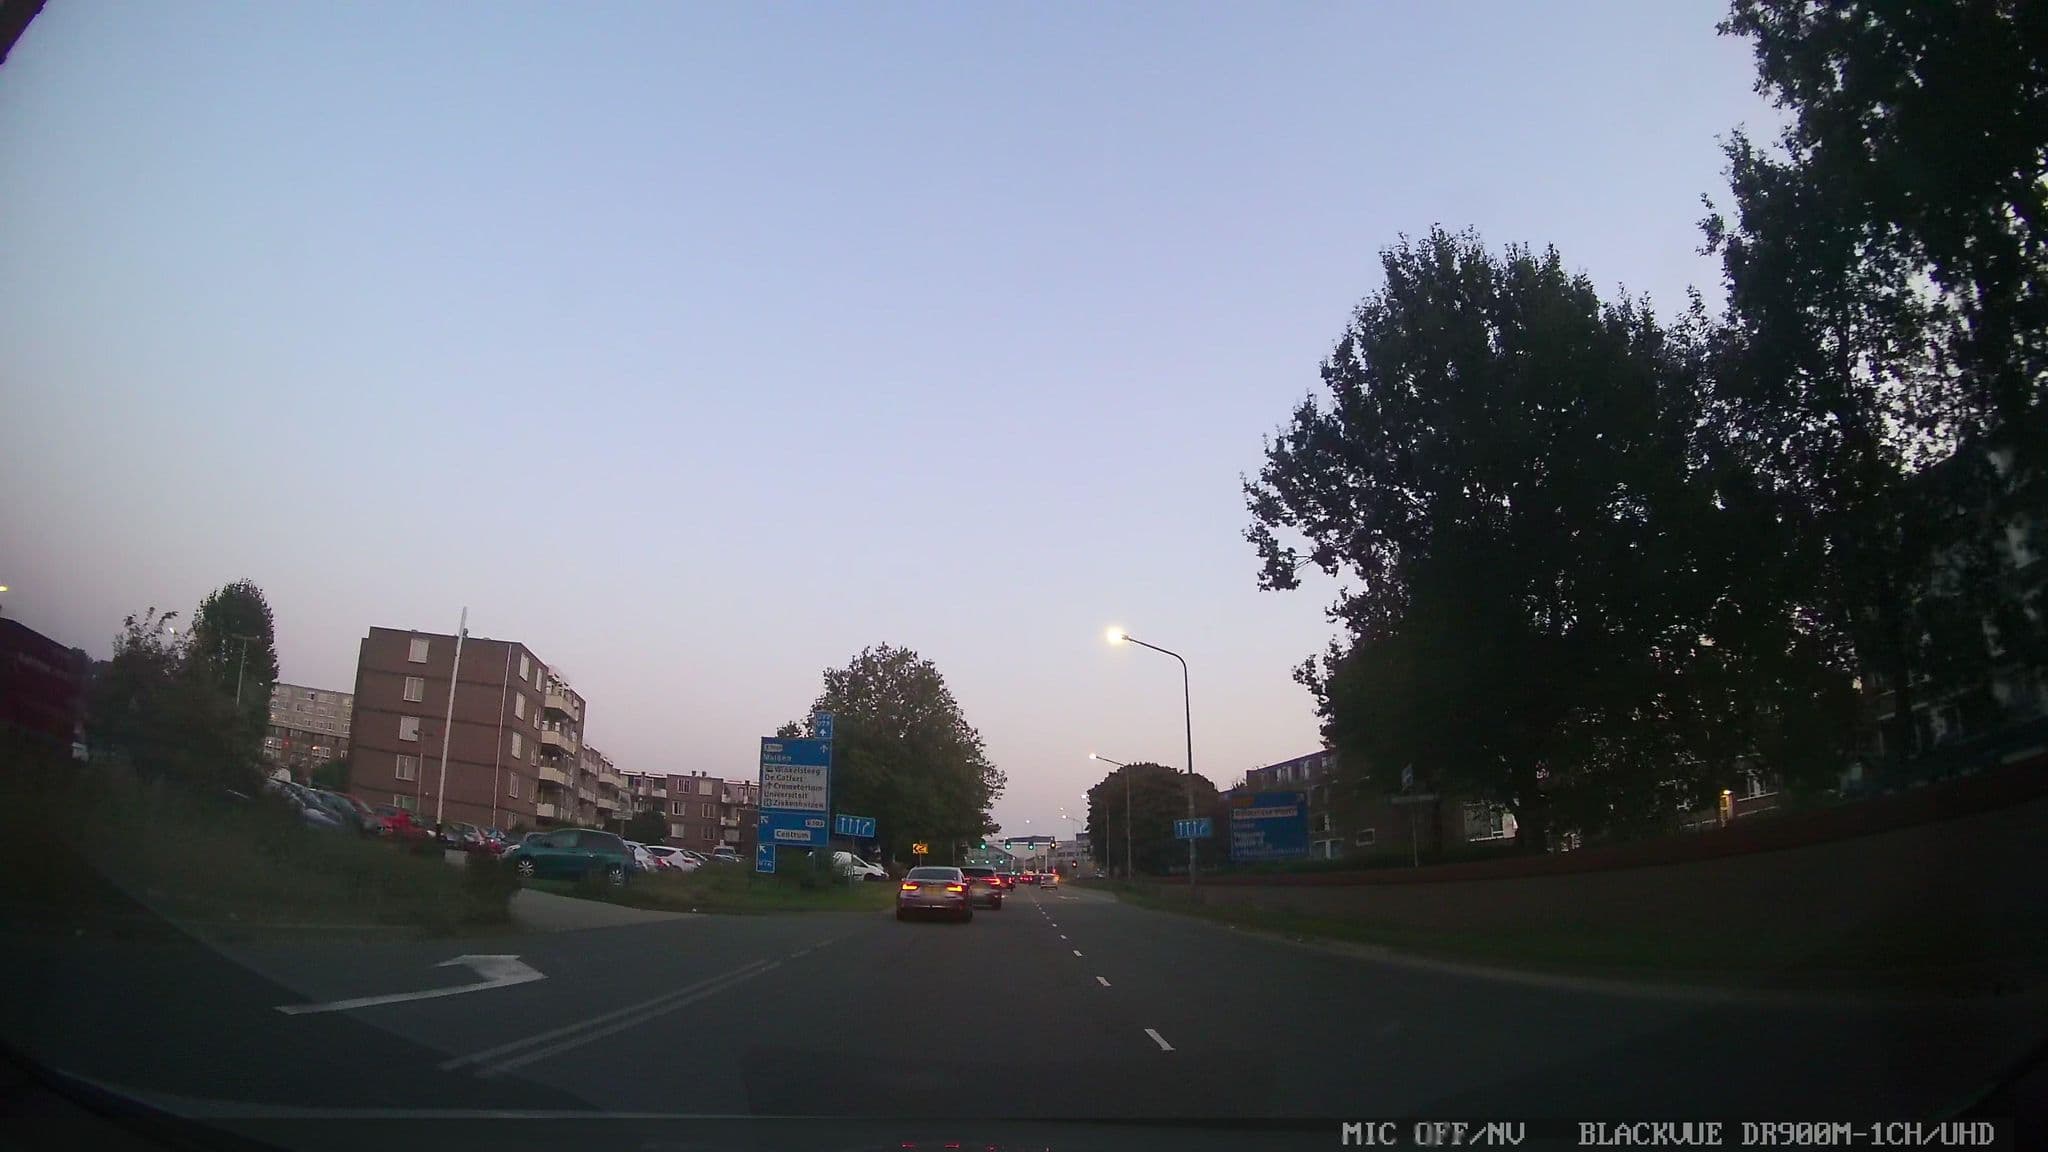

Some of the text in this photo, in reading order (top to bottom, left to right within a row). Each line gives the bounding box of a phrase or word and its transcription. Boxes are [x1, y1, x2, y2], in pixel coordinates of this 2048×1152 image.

[773, 782, 823, 791] Crematorium
[764, 791, 808, 800] Universiteit
[773, 799, 824, 808] Ziekenhuizen
[776, 830, 809, 839] Centrum
